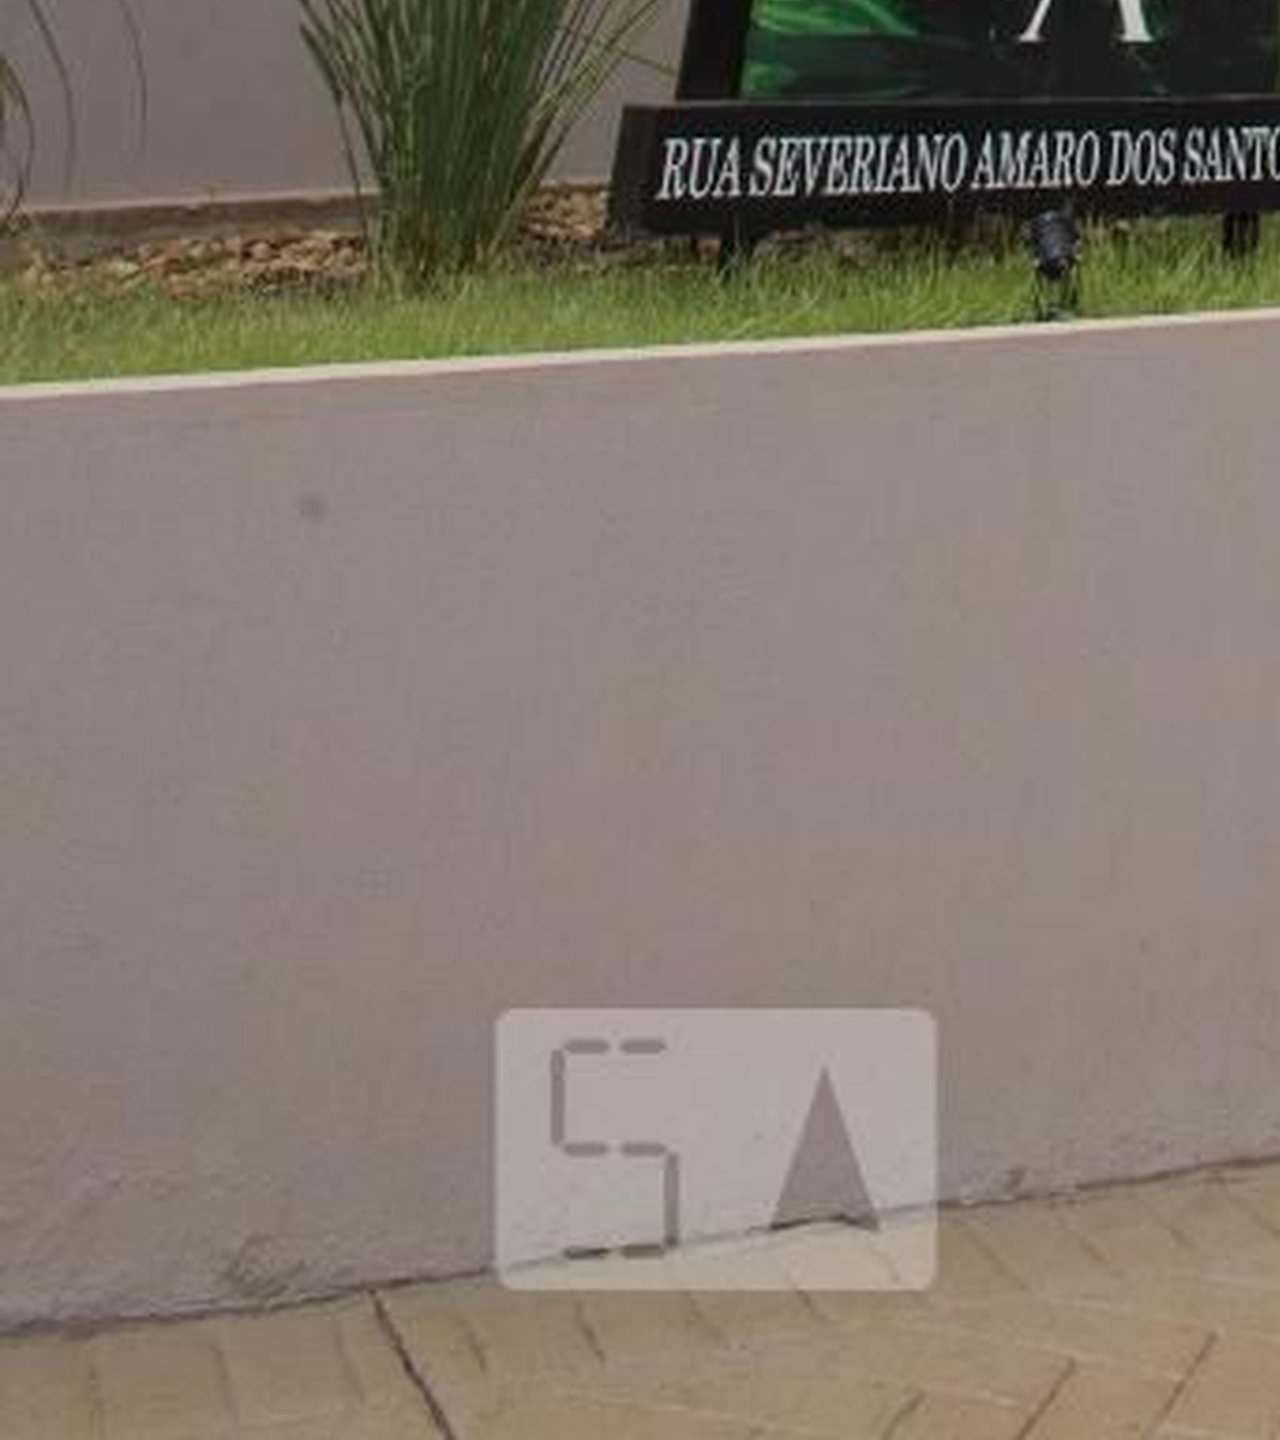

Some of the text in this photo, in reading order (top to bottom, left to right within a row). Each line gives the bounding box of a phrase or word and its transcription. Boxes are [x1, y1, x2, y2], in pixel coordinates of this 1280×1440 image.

[656, 137, 743, 200] RUA
[750, 135, 967, 196] SEVERIANO
[972, 131, 1103, 189] AMARO
[1106, 130, 1180, 185] DOS
